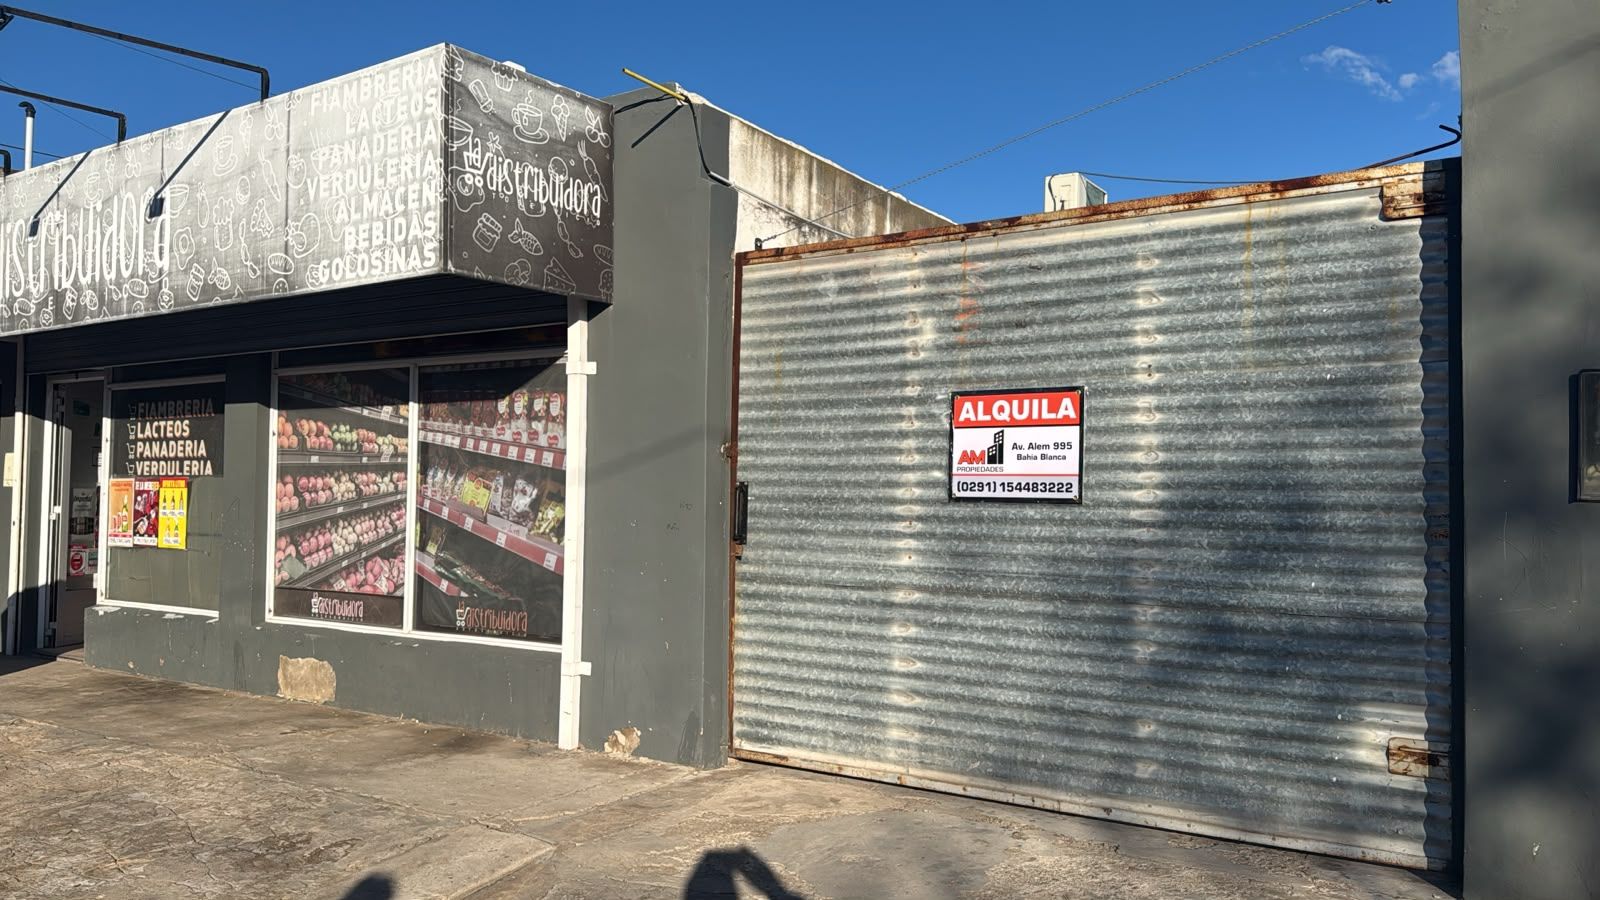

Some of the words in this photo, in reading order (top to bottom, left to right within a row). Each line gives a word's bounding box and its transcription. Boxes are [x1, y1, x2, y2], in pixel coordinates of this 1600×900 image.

[310, 57, 439, 116] FIAMBRERIA
[345, 88, 438, 135] LACTEOS
[318, 119, 439, 170] PANADERIA
[307, 150, 438, 201] VERDULERIA
[486, 154, 601, 220] distribuidora
[337, 180, 436, 224] ALMACEN
[0, 186, 170, 298] istribuidora
[344, 211, 438, 251] BEBIDAS
[318, 245, 437, 283] GOLOSINAS
[138, 398, 215, 420] FIAMBRERIA
[958, 397, 1077, 422] ALQUILA
[137, 419, 190, 439] LACTEOS
[136, 439, 207, 459] PANADERIA
[957, 449, 986, 465] AM
[1011, 442, 1025, 451] Av.
[1028, 442, 1050, 450] Alem
[1053, 442, 1073, 450] 995
[1016, 453, 1038, 461] Bahia
[1040, 453, 1067, 461] Blanca
[136, 460, 213, 476] VERDULERIA
[957, 481, 997, 493] (0291)
[999, 482, 1074, 493] 154483222
[318, 598, 364, 617] distribuidora
[466, 608, 528, 632] distribuidora
